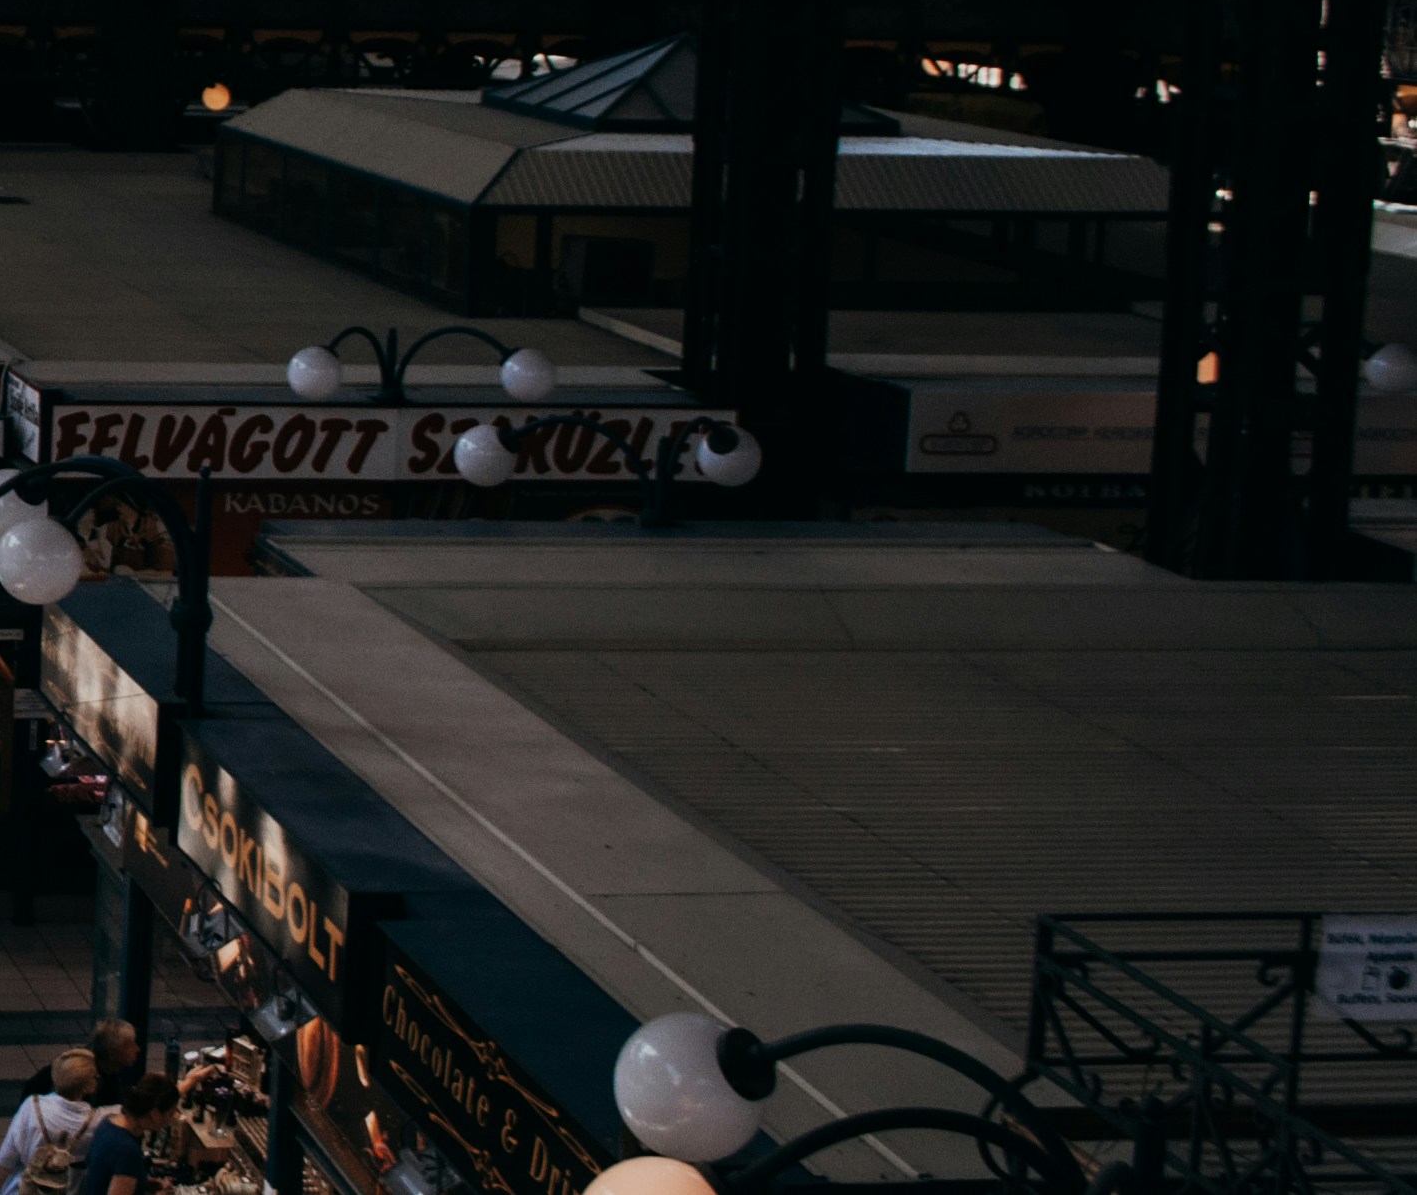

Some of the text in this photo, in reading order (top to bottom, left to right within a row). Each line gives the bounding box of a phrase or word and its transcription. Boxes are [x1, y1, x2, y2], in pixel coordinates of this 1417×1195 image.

[56, 407, 389, 474] FELVÁGOTT
[223, 491, 381, 515] KABANOS
[382, 983, 582, 1195] Chocolate & Dri
